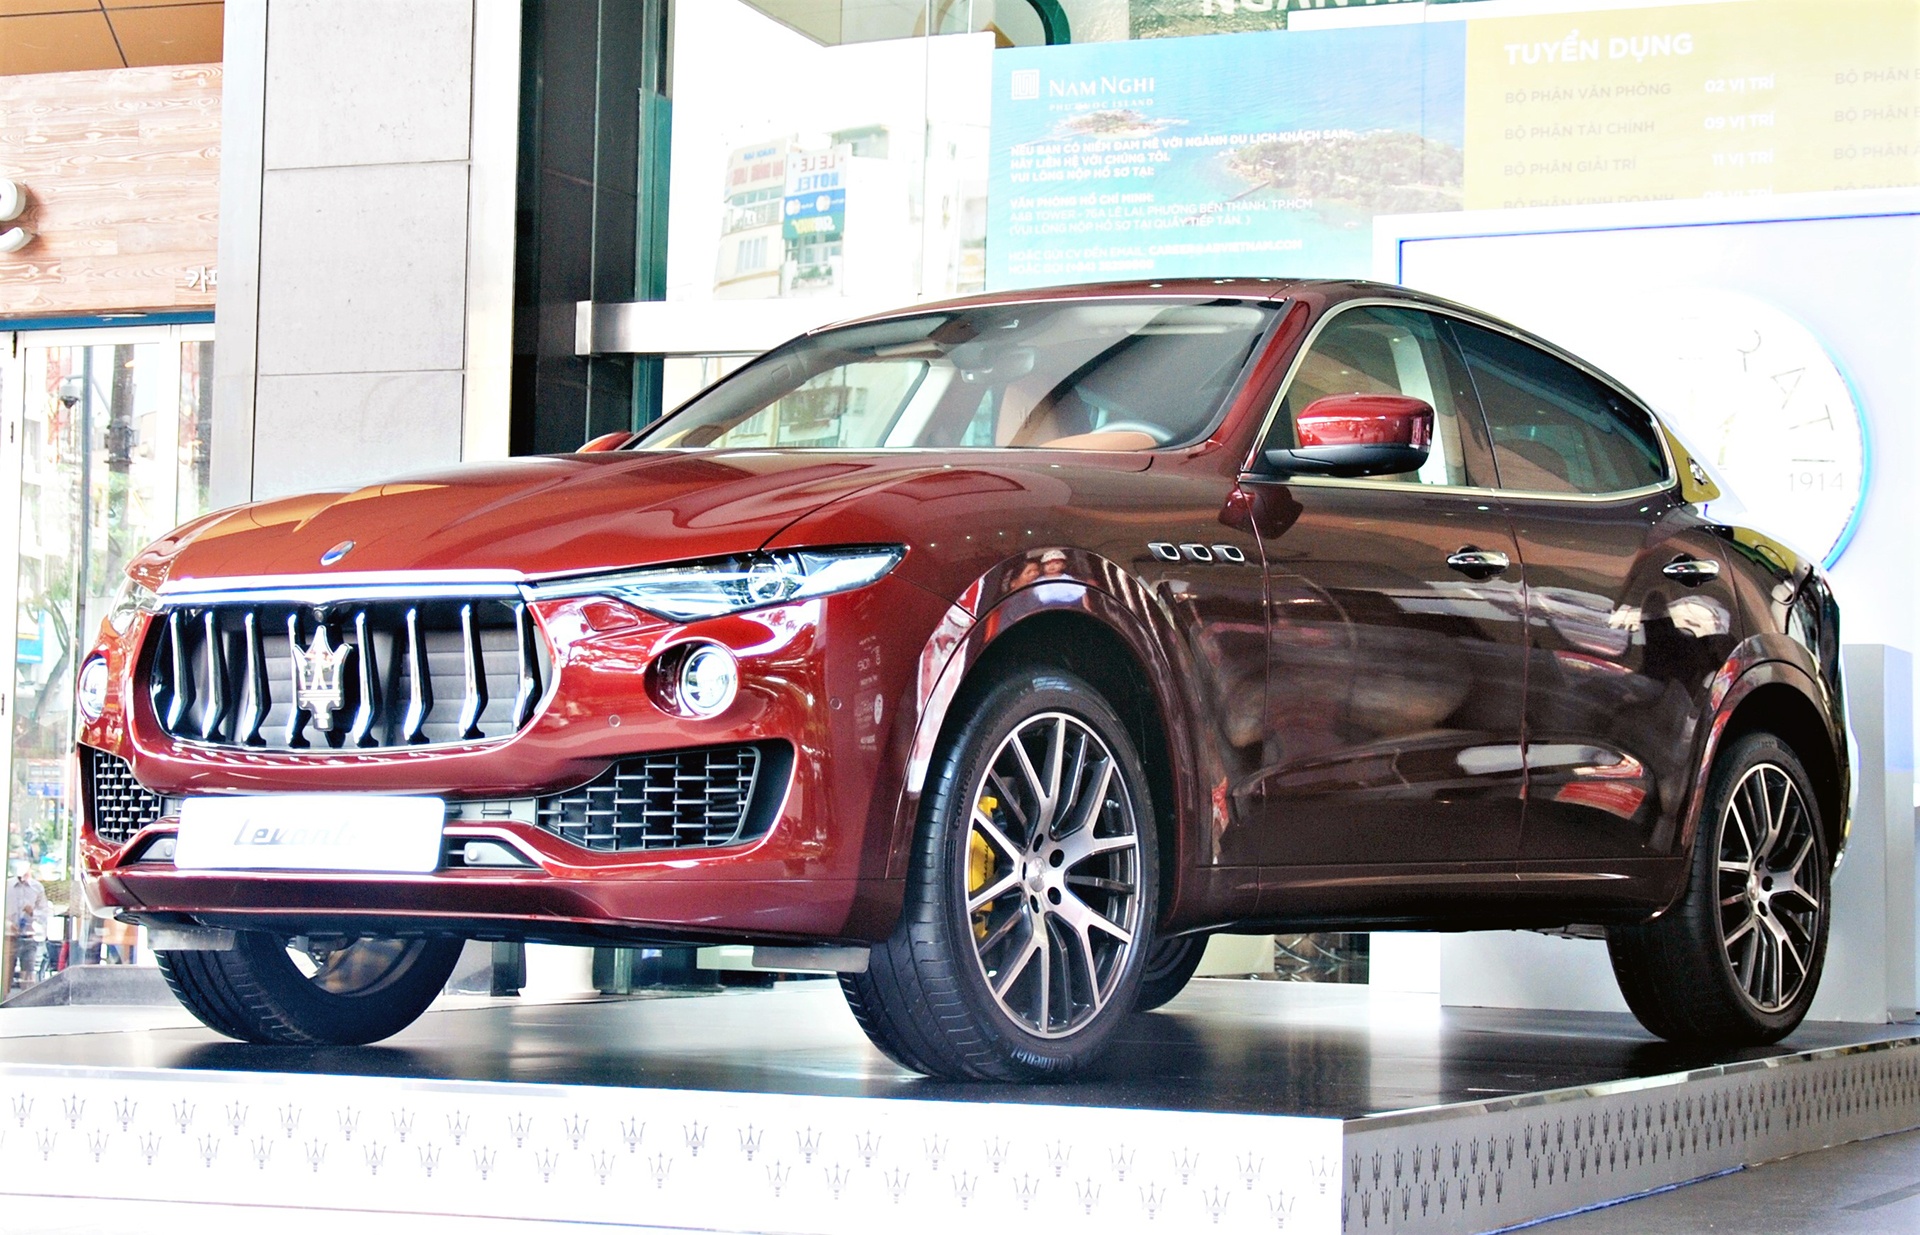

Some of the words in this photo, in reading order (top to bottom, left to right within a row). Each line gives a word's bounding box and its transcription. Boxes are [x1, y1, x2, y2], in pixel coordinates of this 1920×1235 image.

[1504, 29, 1599, 65] TUYỂN
[1609, 32, 1693, 63] DỤNG
[1048, 79, 1096, 97] NAM
[1101, 75, 1155, 95] NGHI
[1704, 79, 1725, 93] 02
[1729, 77, 1745, 94] VỊ
[1749, 72, 1775, 90] TRÍ
[1834, 69, 1859, 87] BỘ
[1863, 66, 1909, 85] PHẬN
[1112, 98, 1154, 109] ISLAND
[1505, 89, 1526, 105] BỘ
[1531, 86, 1573, 104] PHẬN
[1578, 84, 1611, 99] VĂN
[1615, 81, 1671, 97] PHÒNG
[1704, 116, 1725, 130] 09
[1729, 114, 1745, 131] VỊ
[1749, 109, 1775, 127] TRÍ
[1834, 107, 1858, 124] BỘ
[1862, 105, 1908, 123] PHẬN
[1504, 125, 1526, 141] BỘ
[1530, 123, 1573, 141] PHẬN
[1577, 120, 1602, 136] TÀI
[1606, 119, 1655, 135] CHÍNH
[1063, 142, 1080, 154] CÓ
[1711, 152, 1724, 166] 11
[1729, 151, 1745, 168] VỊ
[1749, 147, 1775, 165] TRÍ
[1833, 144, 1857, 161] BỘ
[1861, 143, 1908, 161] PHẬN
[1504, 161, 1525, 178] BỘ
[1530, 159, 1573, 177] PHẬN
[1576, 155, 1608, 173] GIẢI
[1612, 155, 1637, 171] TRÍ
[1036, 209, 1076, 220] TOWER
[1788, 471, 1844, 492] 1914
